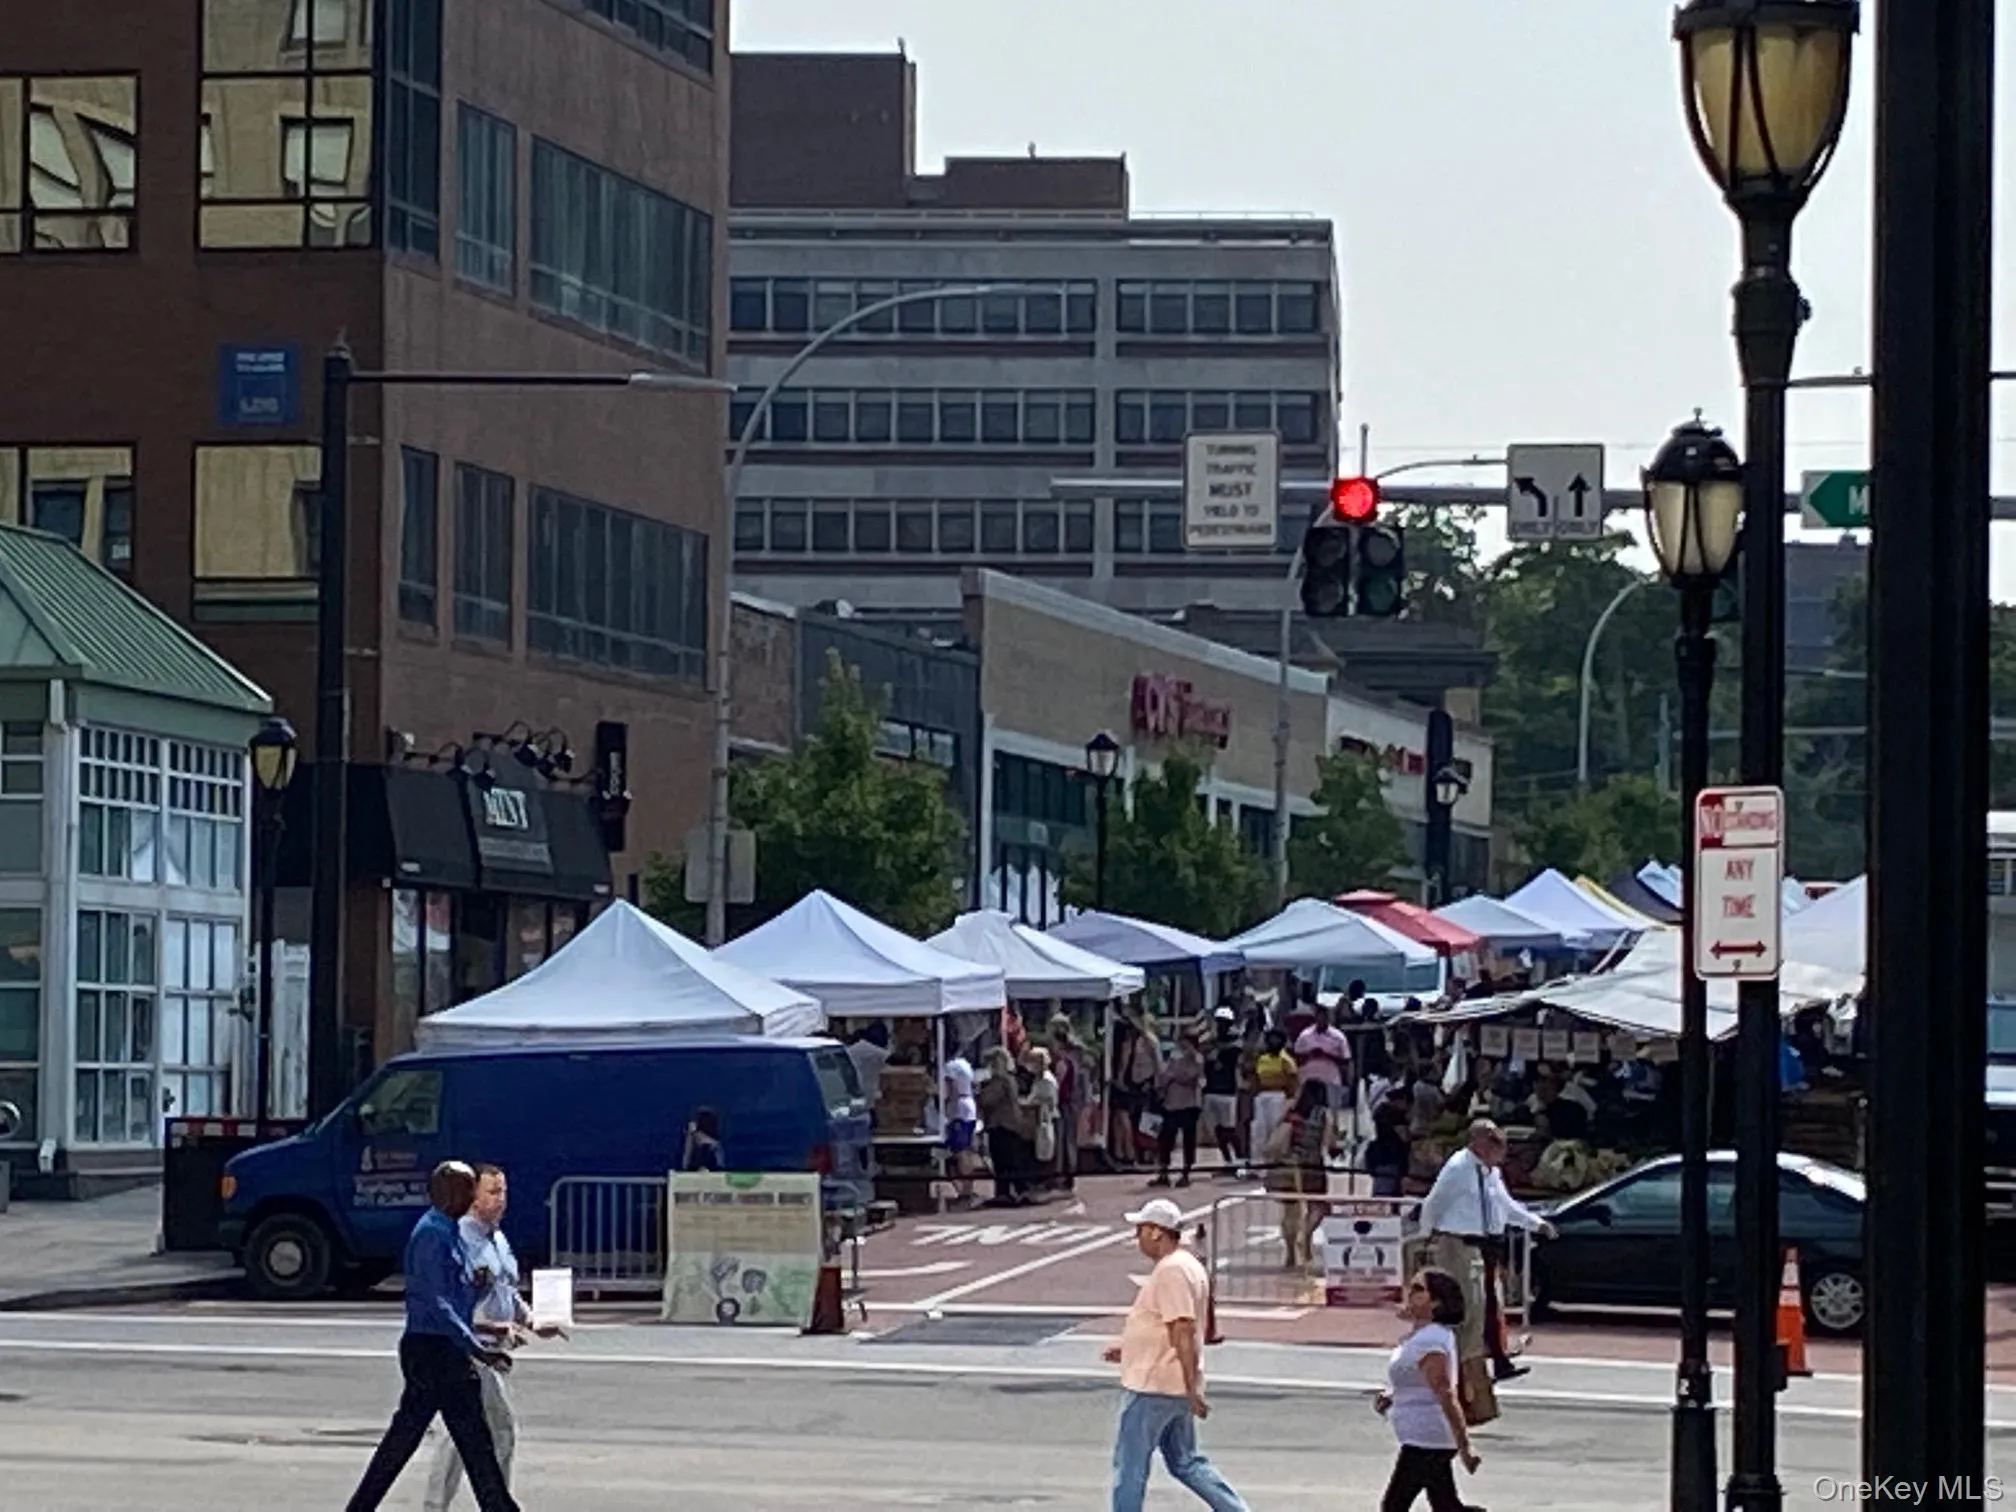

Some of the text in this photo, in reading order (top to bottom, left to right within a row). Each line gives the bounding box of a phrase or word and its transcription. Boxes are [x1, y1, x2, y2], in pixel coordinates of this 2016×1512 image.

[1208, 482, 1253, 497] MUST
[1725, 858, 1755, 880] ANY
[1722, 894, 1757, 918] TIME
